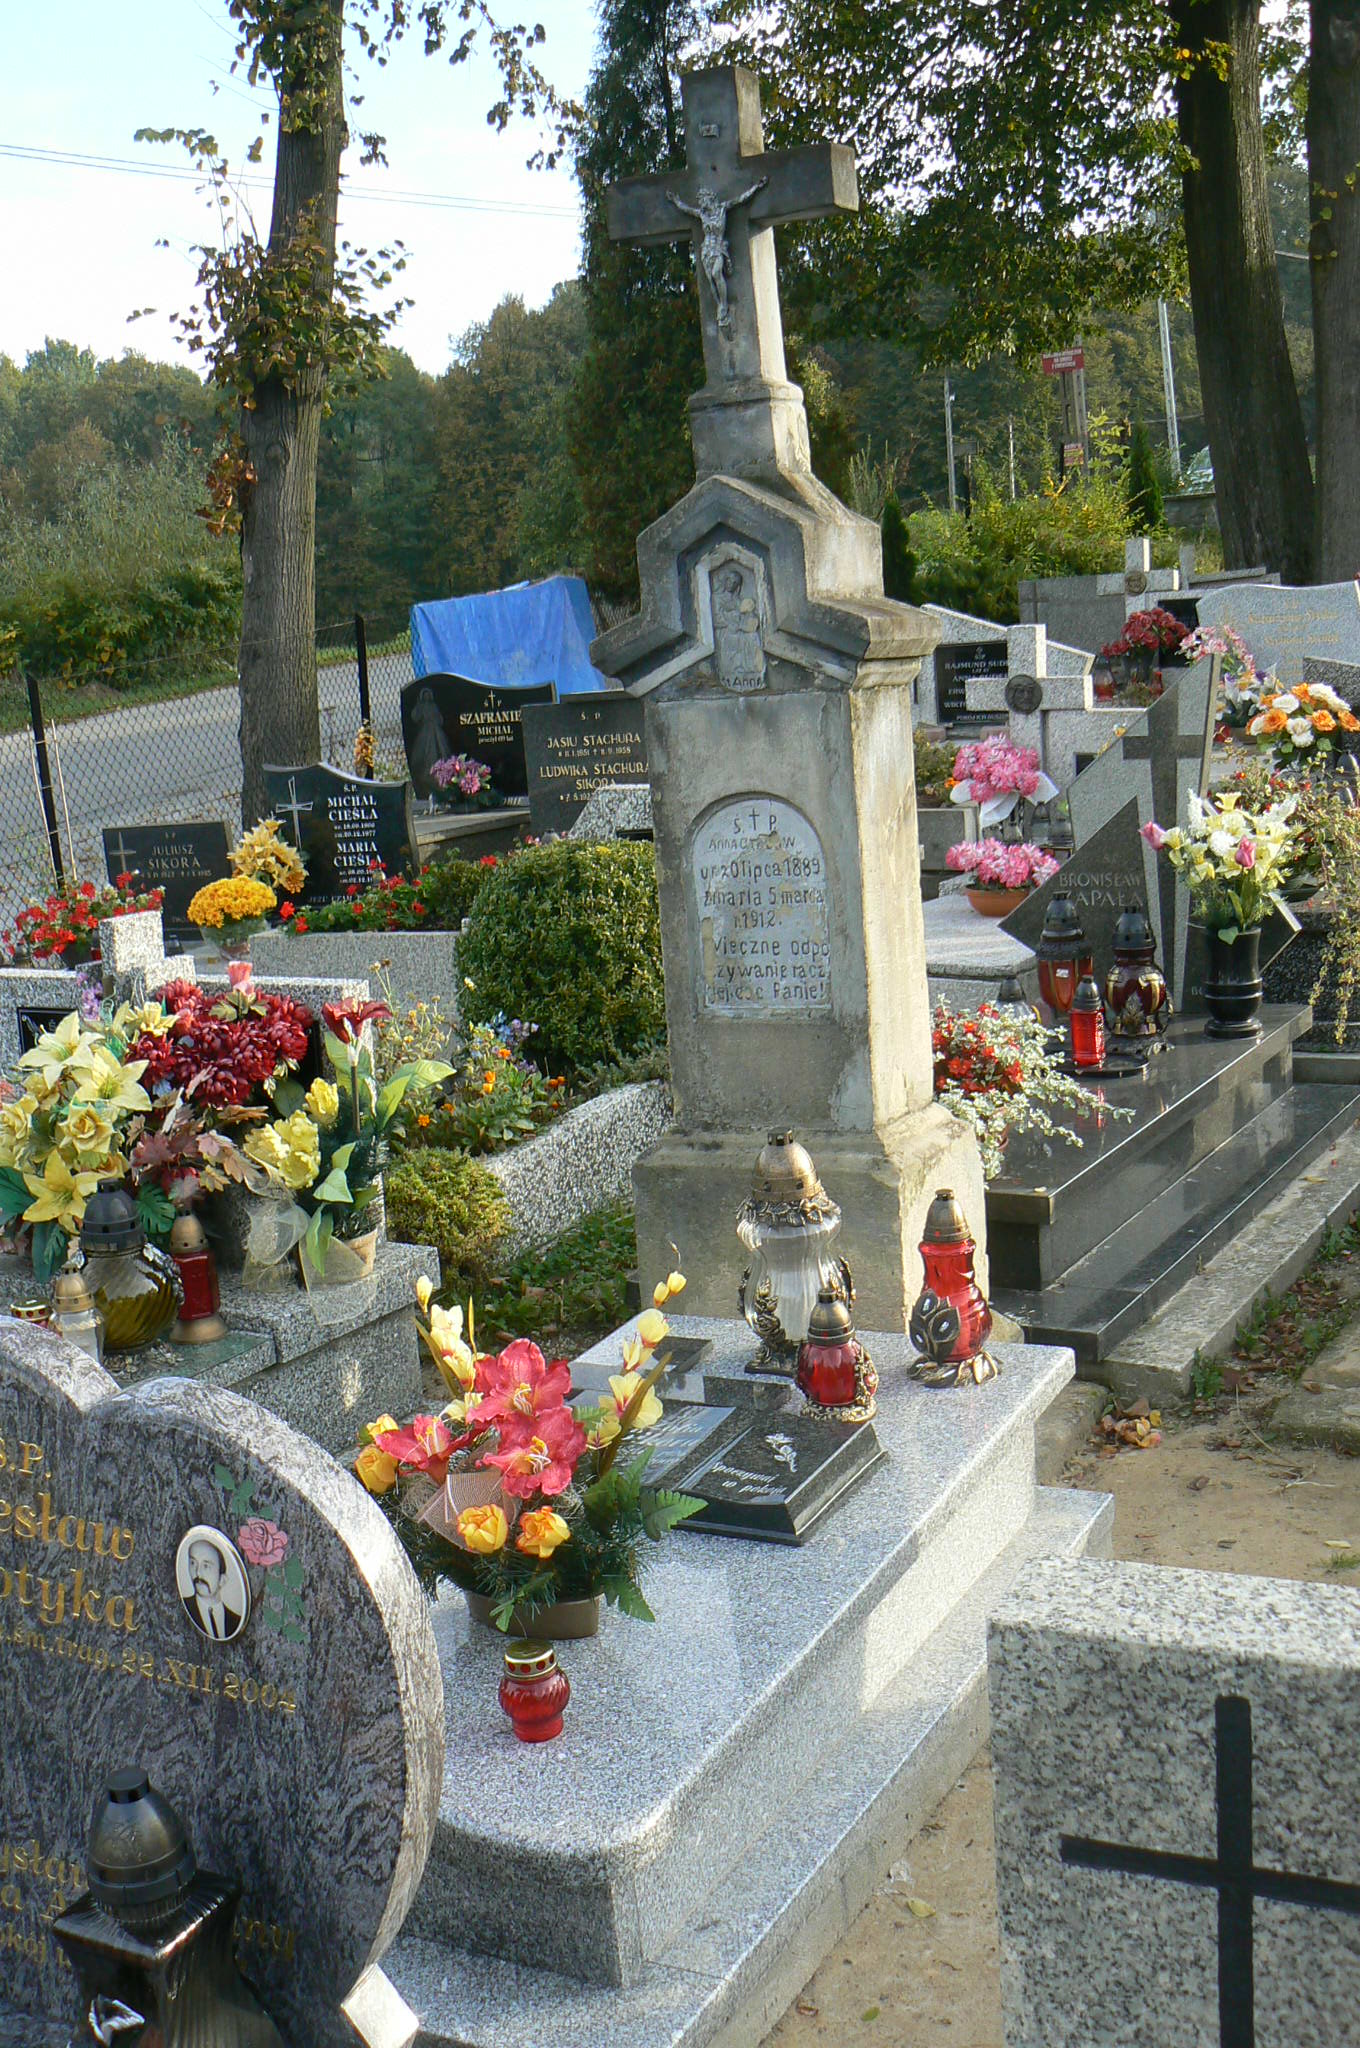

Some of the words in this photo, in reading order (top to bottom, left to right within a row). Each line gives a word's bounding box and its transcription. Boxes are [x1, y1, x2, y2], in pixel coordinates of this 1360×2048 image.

[547, 736, 578, 749] JASIU
[583, 732, 641, 746] STACHURA
[540, 765, 589, 778] LUDWIKA
[151, 844, 194, 856] JULIUSZ
[336, 842, 378, 854] MARIA
[148, 857, 201, 870] SIKORA
[783, 857, 820, 877] 1889
